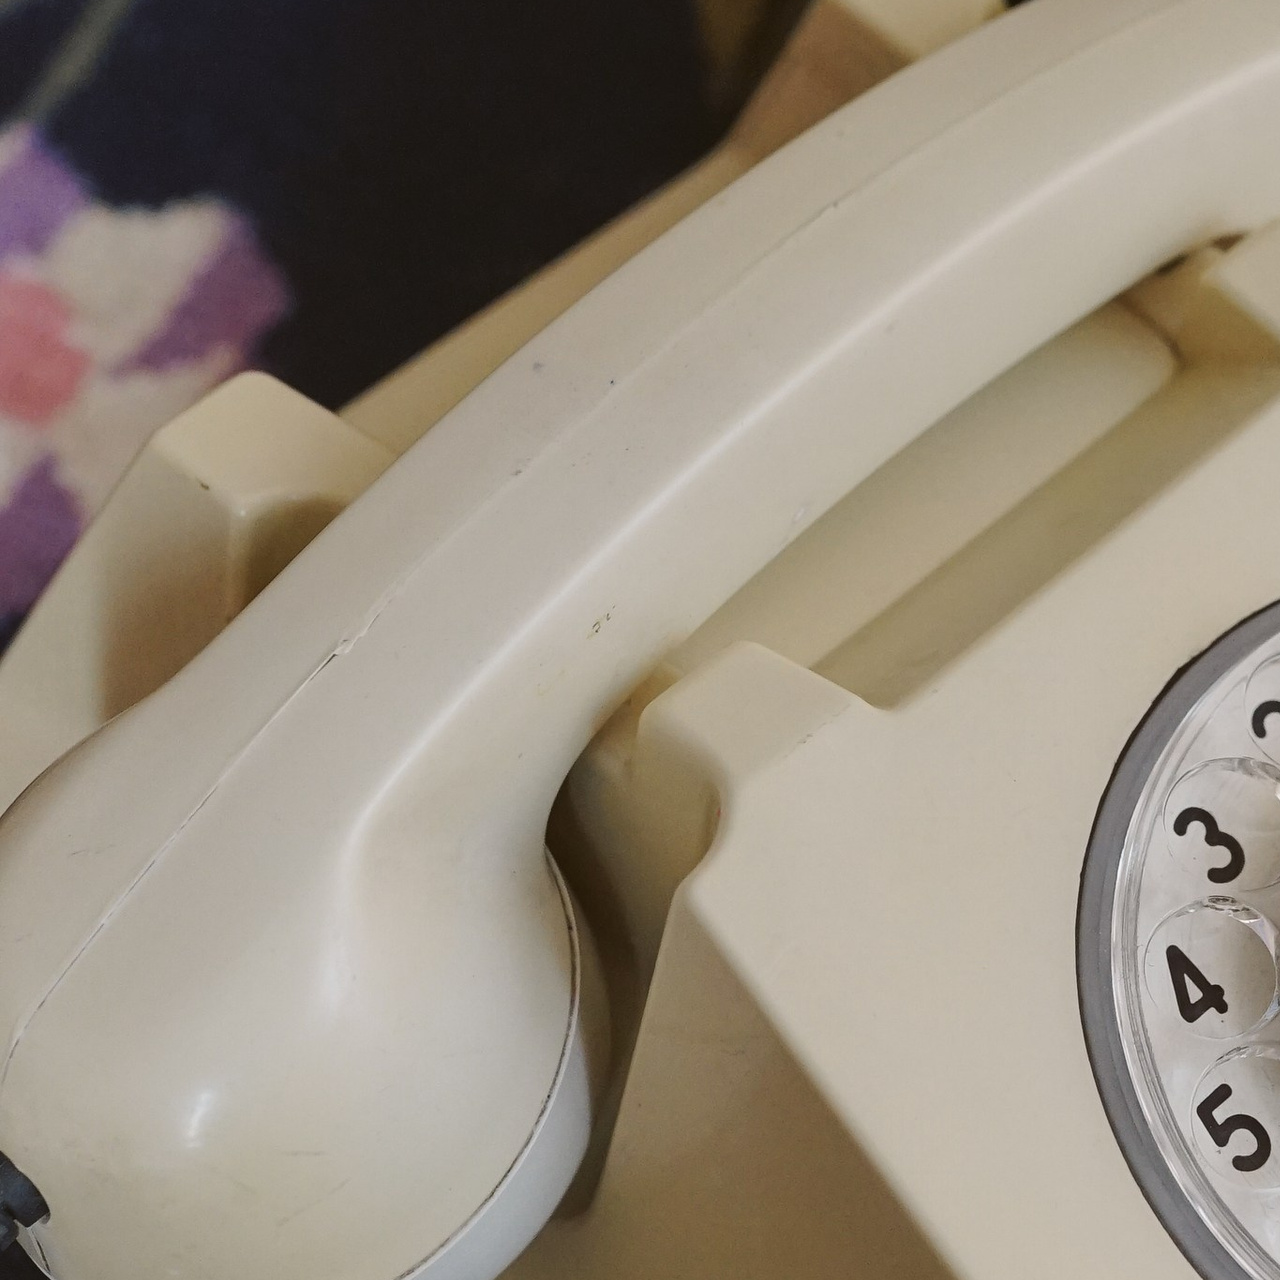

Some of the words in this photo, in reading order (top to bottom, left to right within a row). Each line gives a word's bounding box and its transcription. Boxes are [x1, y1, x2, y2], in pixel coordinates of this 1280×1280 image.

[1173, 806, 1246, 884] 3
[1165, 944, 1229, 1024] 4
[1196, 1083, 1272, 1173] 5
